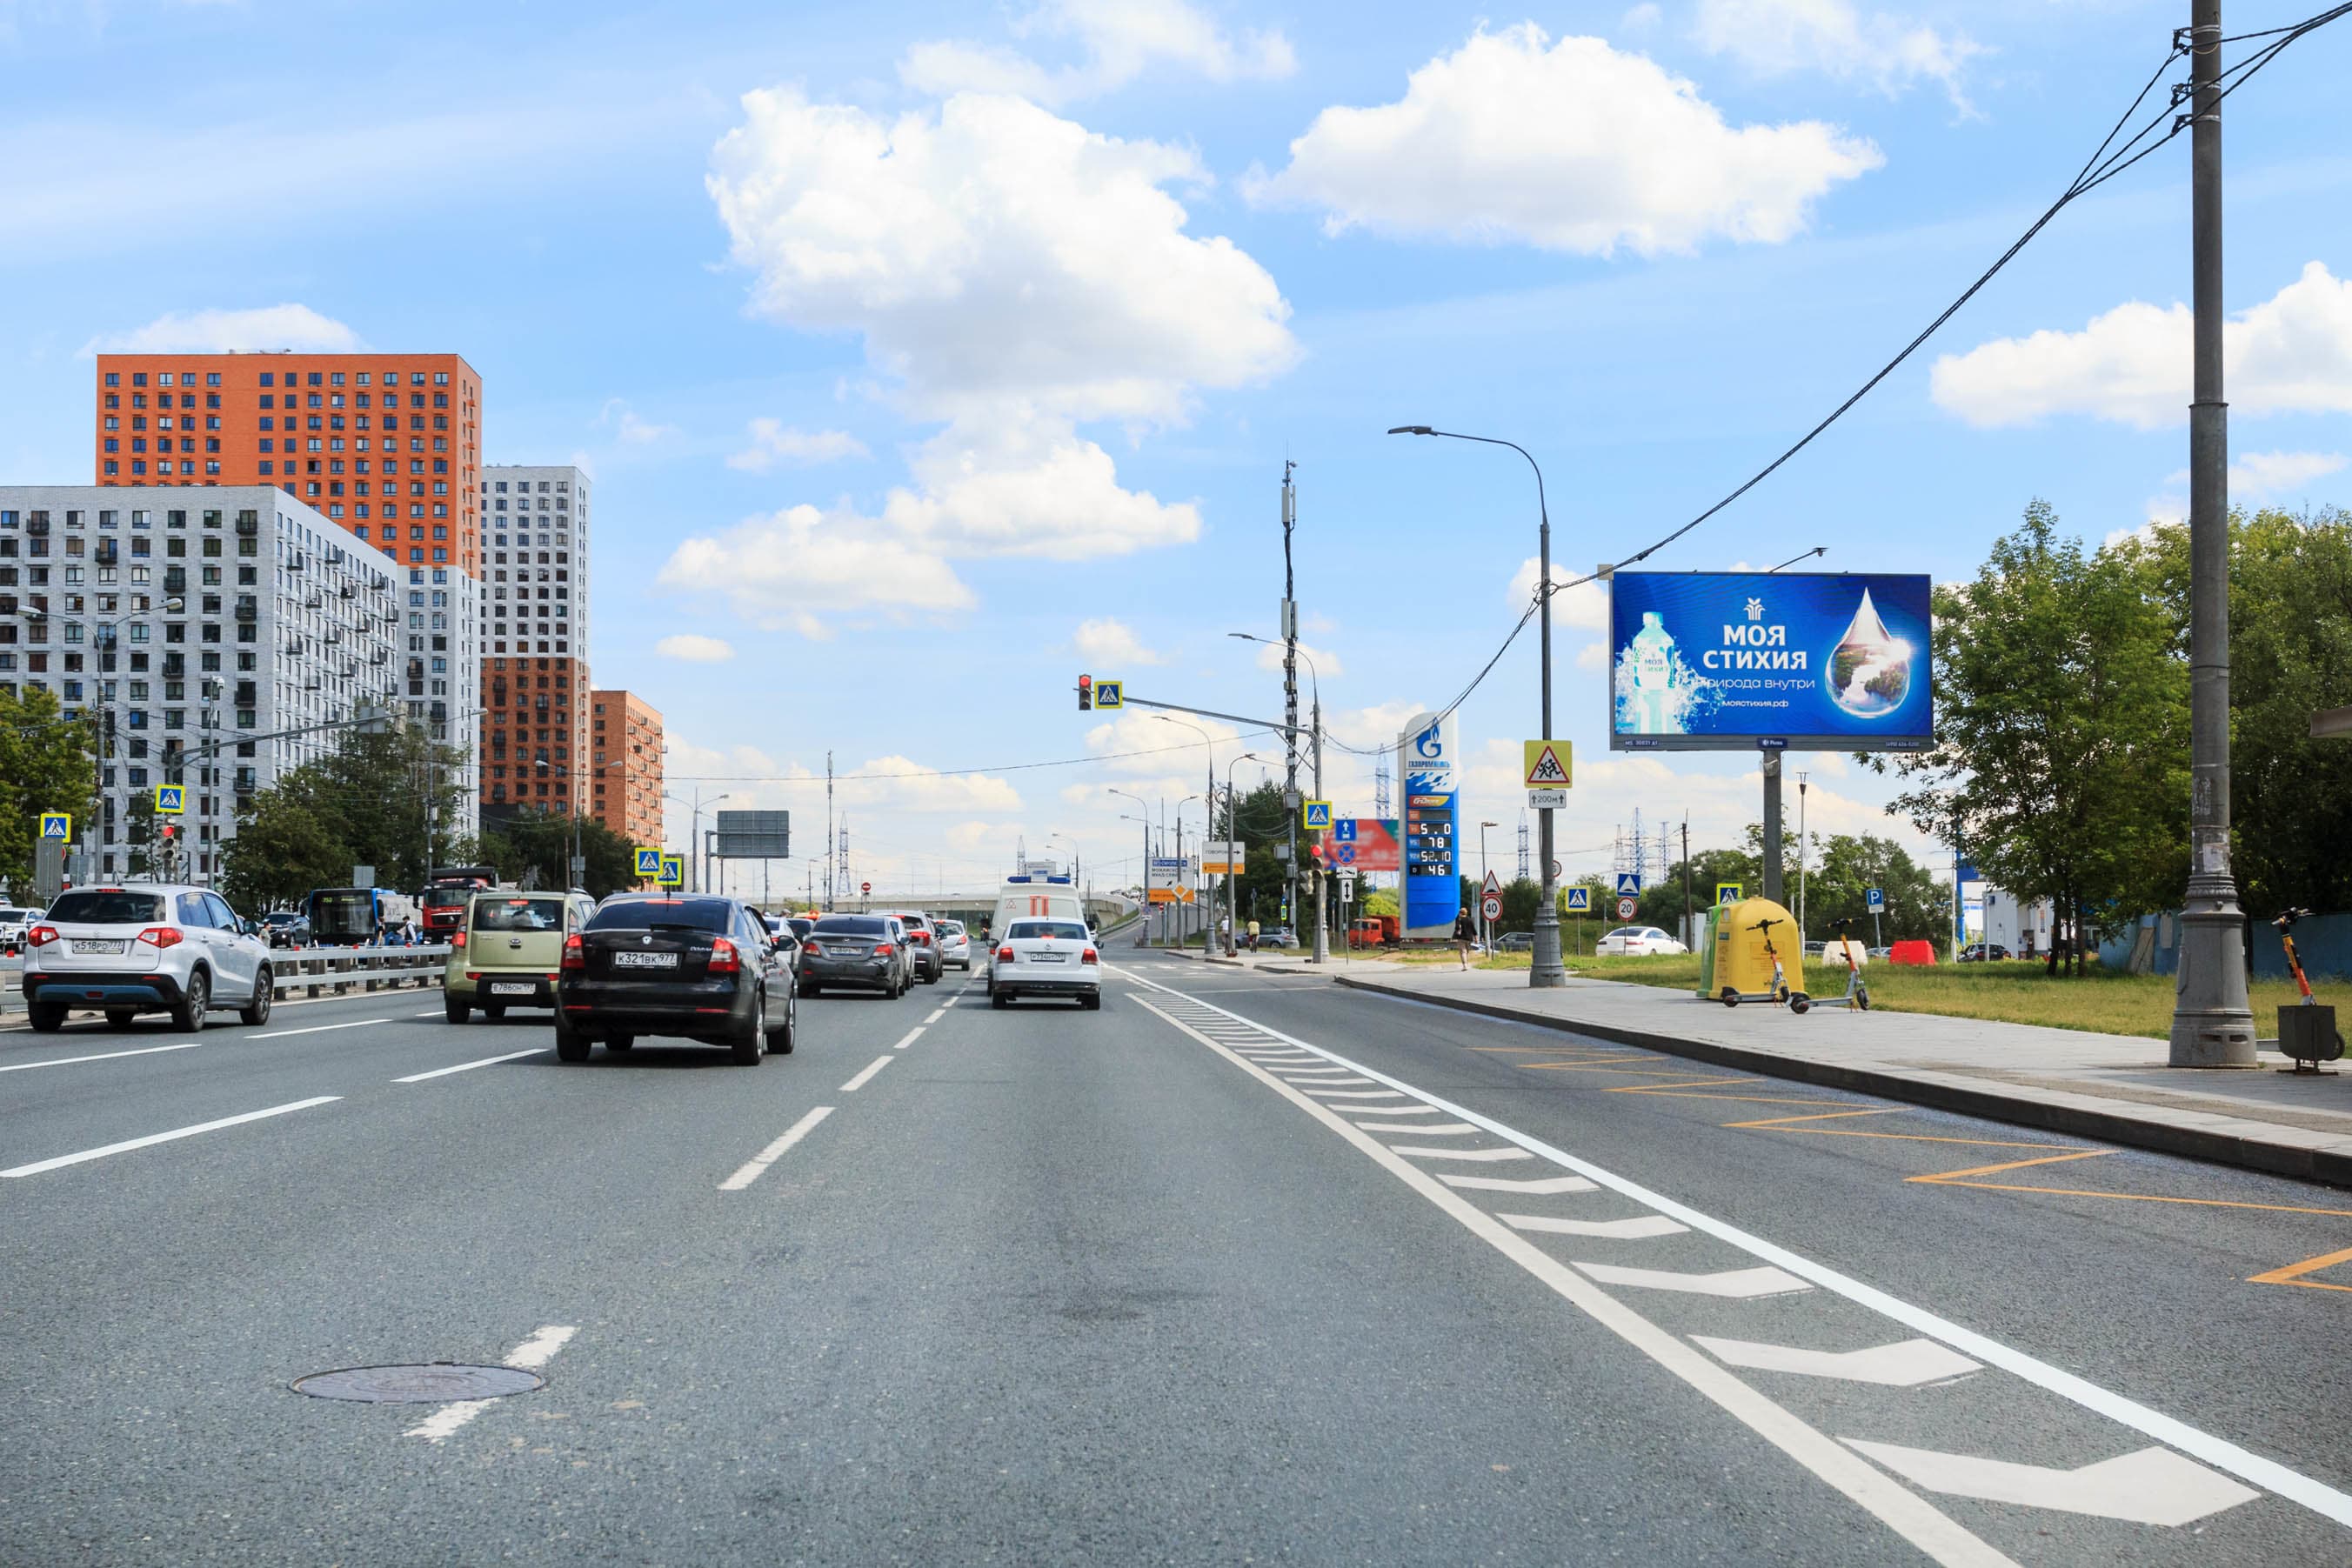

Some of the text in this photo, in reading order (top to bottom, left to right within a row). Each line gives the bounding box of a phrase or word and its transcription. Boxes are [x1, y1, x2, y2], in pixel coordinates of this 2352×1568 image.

[1723, 624, 1786, 646] МОЯ
[1703, 651, 1807, 670] СТИХИЯ
[1764, 678, 1815, 691] внутри
[1428, 837, 1445, 849] 78
[1428, 864, 1445, 877] 46
[1486, 903, 1498, 913] 40
[1620, 904, 1633, 913] 20
